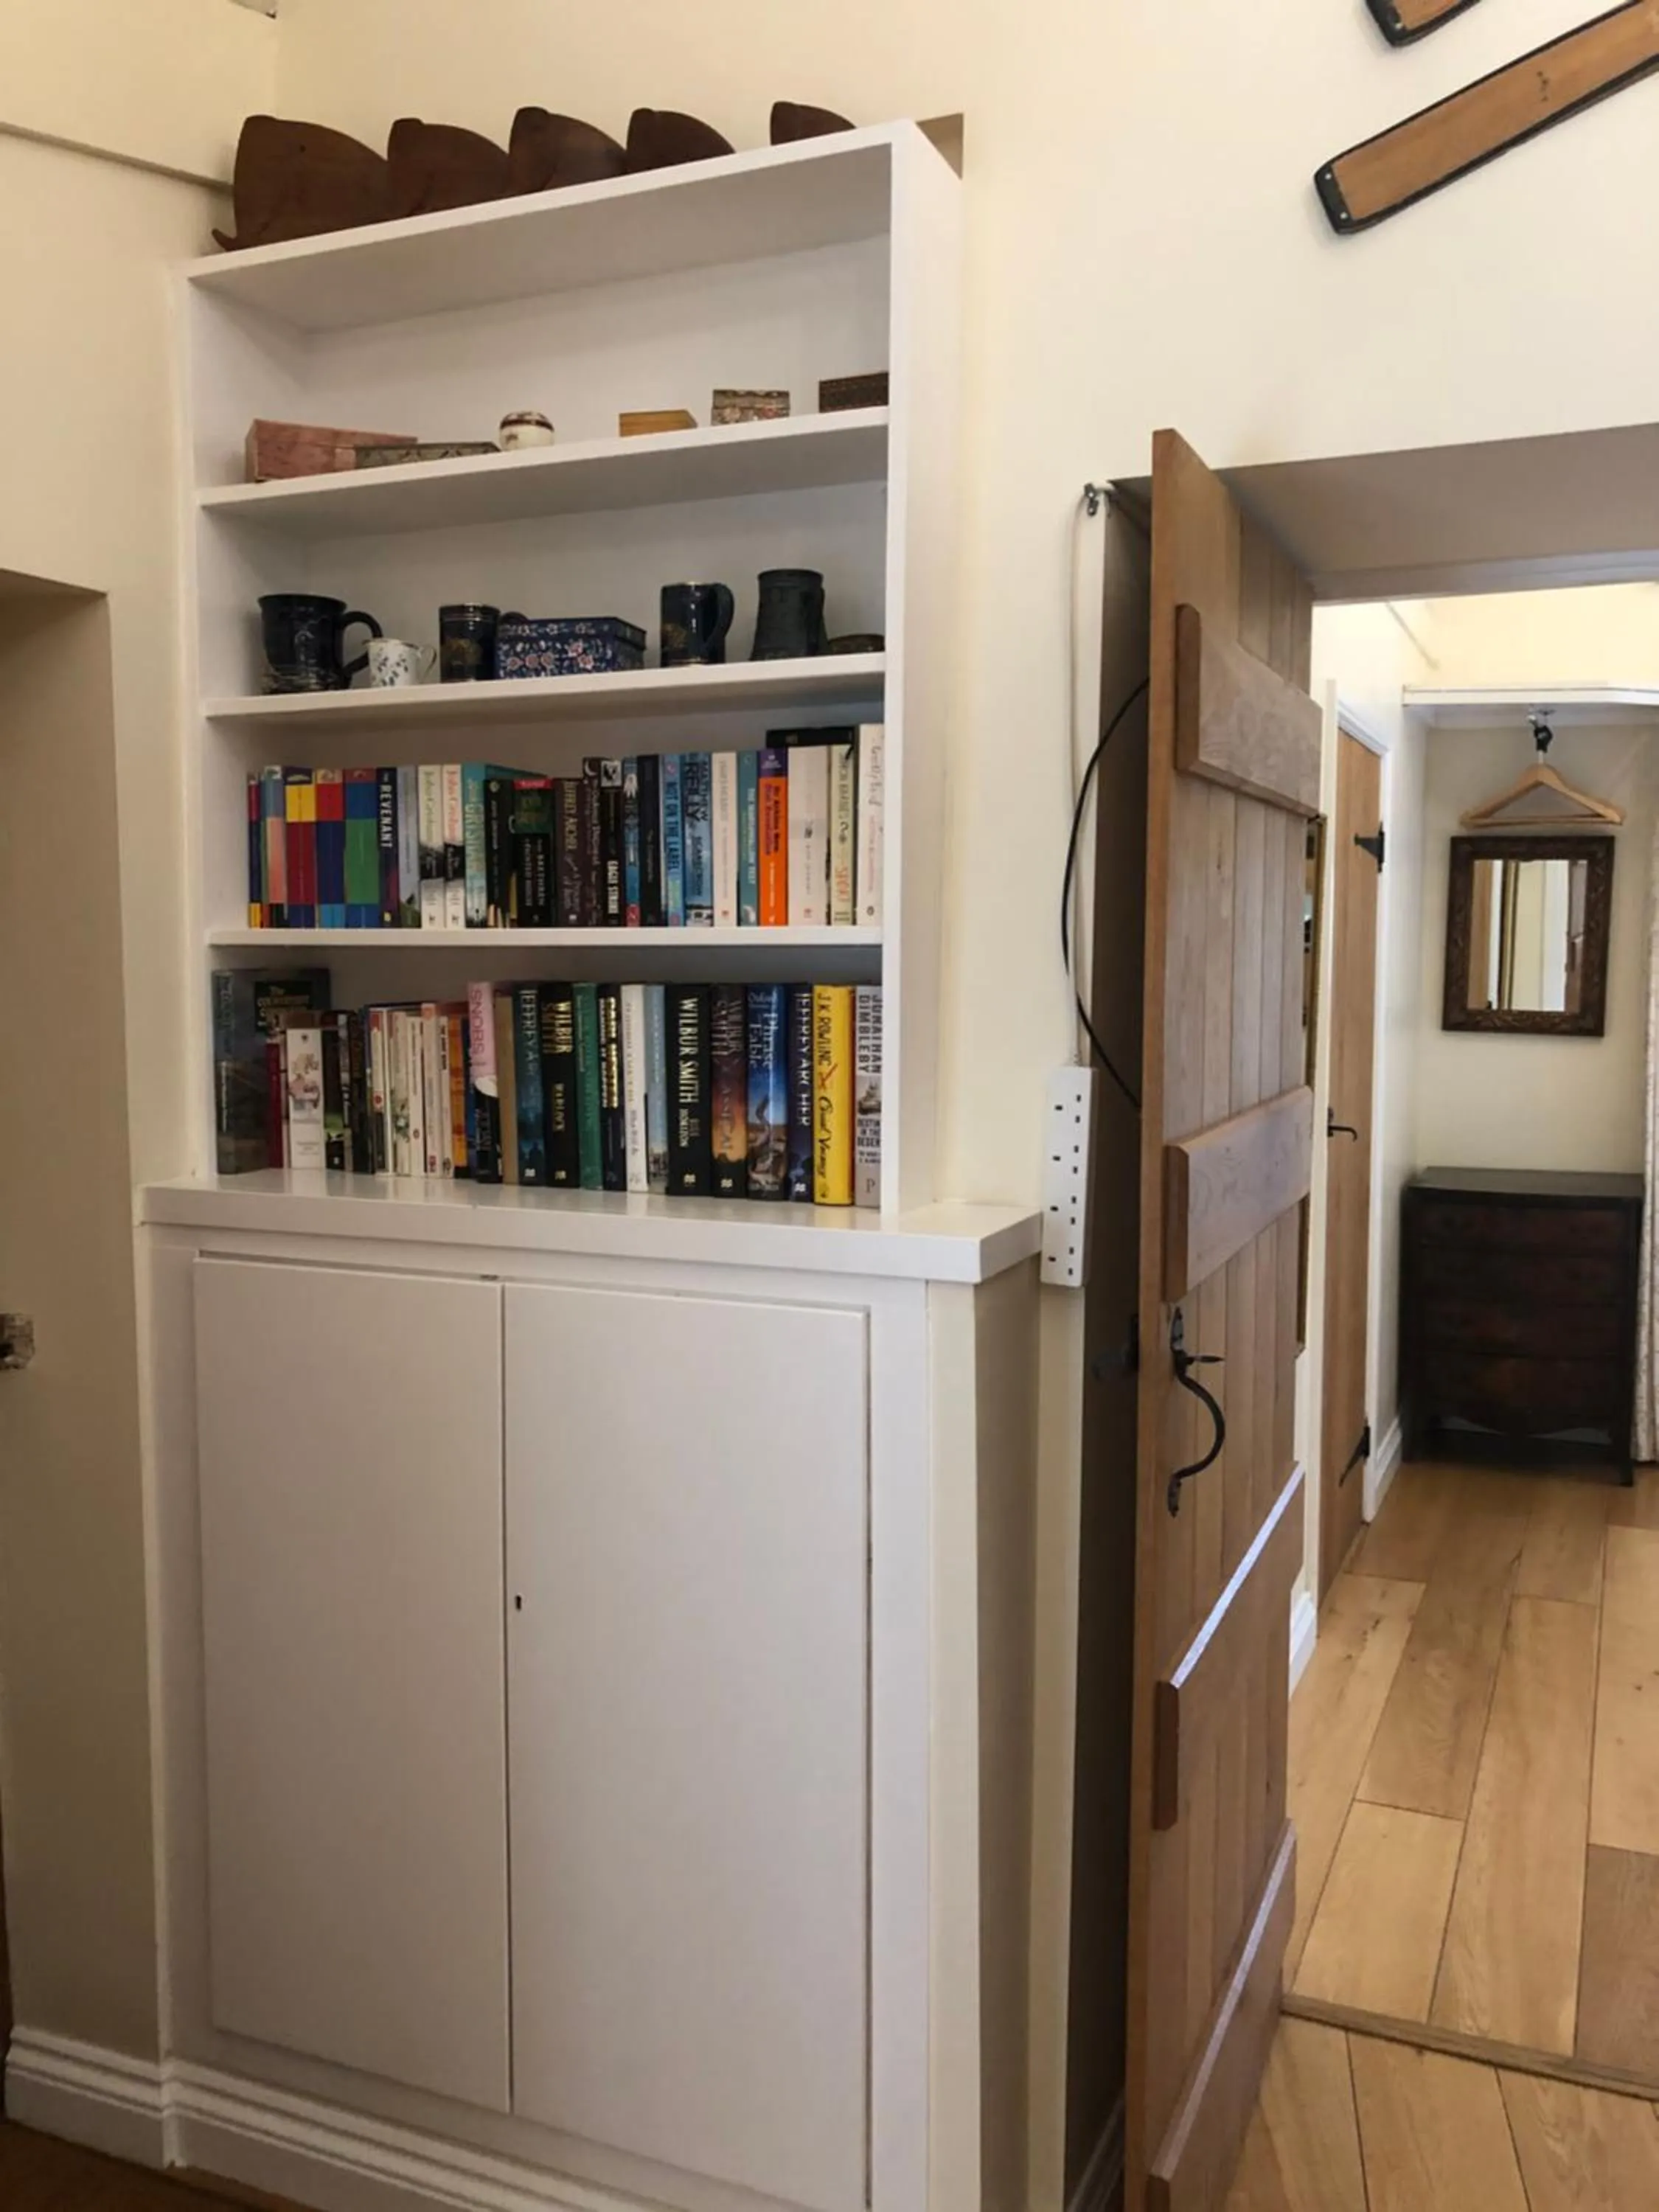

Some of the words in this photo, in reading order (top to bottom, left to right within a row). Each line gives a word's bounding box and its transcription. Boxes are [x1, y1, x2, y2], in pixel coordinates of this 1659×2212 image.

[380, 784, 393, 849] REVENANT
[667, 782, 678, 800] NOT
[667, 804, 678, 817] ON
[685, 762, 700, 821] REILLY
[667, 821, 679, 837] THE
[668, 841, 680, 872] LABEL
[470, 989, 485, 1054] SNOBS
[519, 990, 539, 1048] JEFFREY
[554, 1001, 573, 1053] WILBUR
[678, 998, 699, 1056] WILBUR
[748, 1023, 763, 1068] Fable
[762, 1012, 779, 1068] Phrase
[794, 992, 812, 1053] JEFFREY
[817, 1015, 832, 1066] ROWLING
[858, 994, 871, 1074] DIMBLEBY
[678, 1060, 700, 1104] SMITH
[796, 1057, 812, 1127] ARCHER
